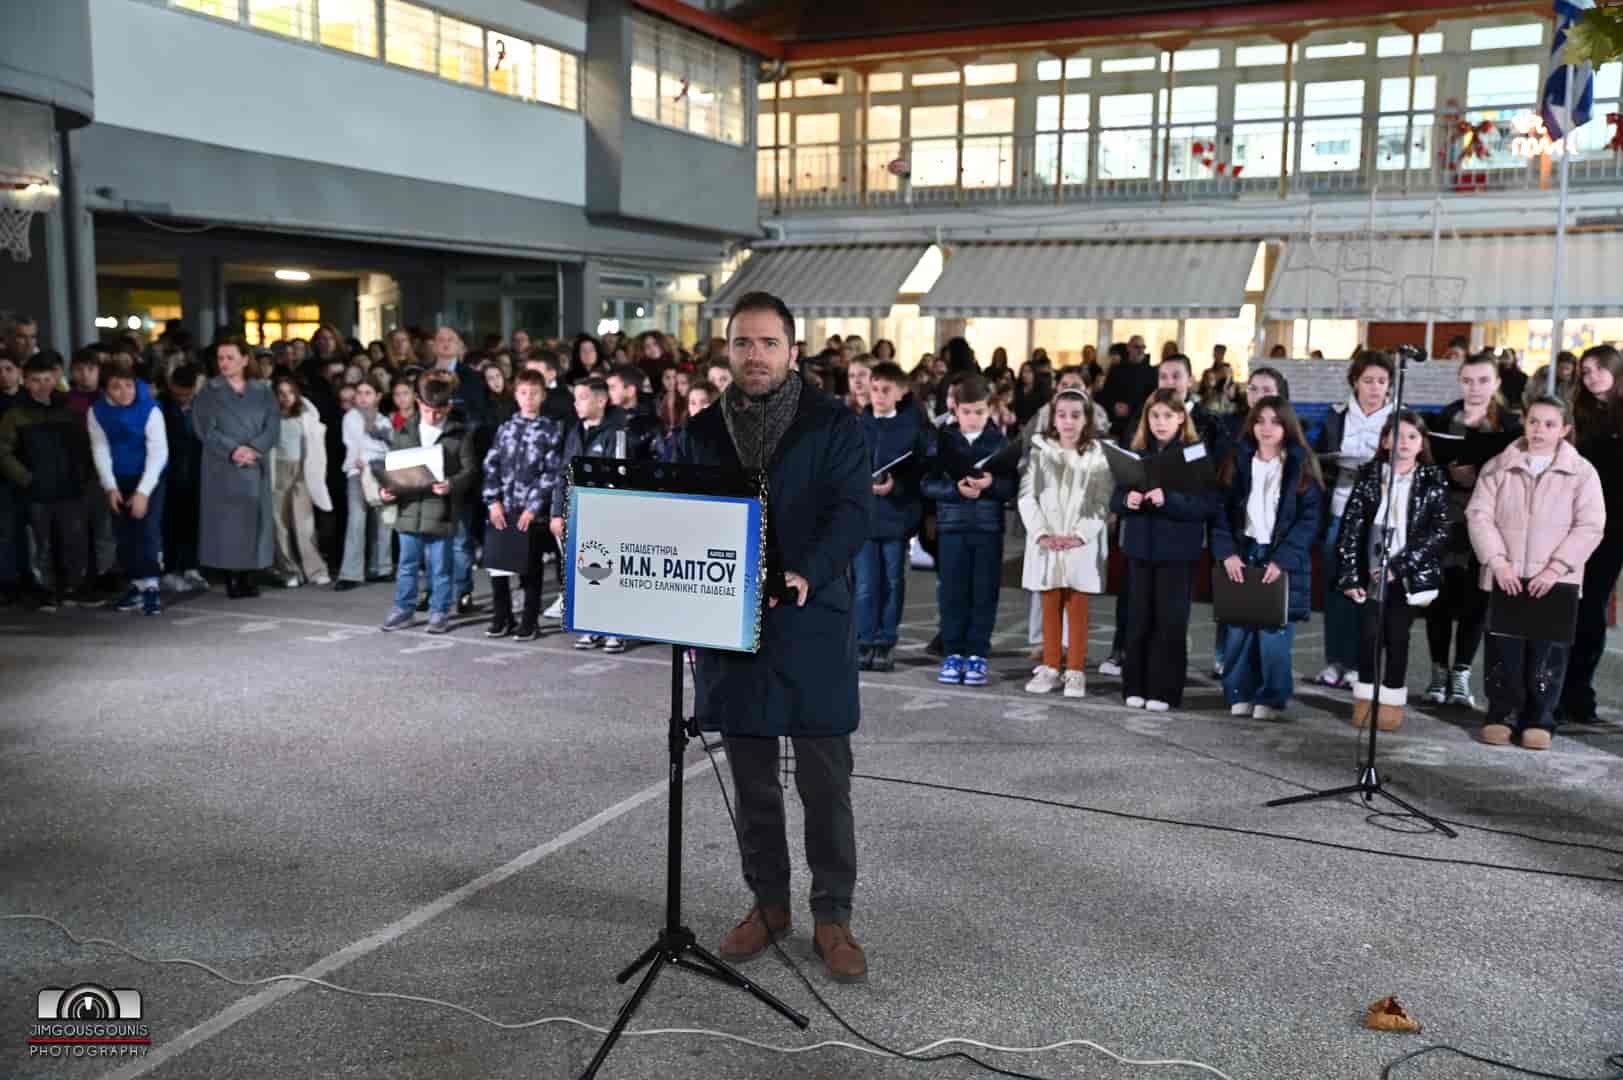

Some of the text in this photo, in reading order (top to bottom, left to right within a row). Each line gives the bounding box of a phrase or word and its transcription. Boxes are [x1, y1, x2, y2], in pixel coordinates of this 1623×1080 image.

[620, 542, 678, 556] ΕΚΠΑΙΔΕΥΤΗΡΙΑ
[663, 558, 737, 583] ΡΑΠΤΟΥ
[619, 578, 737, 597] ΚΕΝΤΡΟ ΕΛΛΗΝΙΚΗΣ ΠΑΙΔΕΙΑΣ
